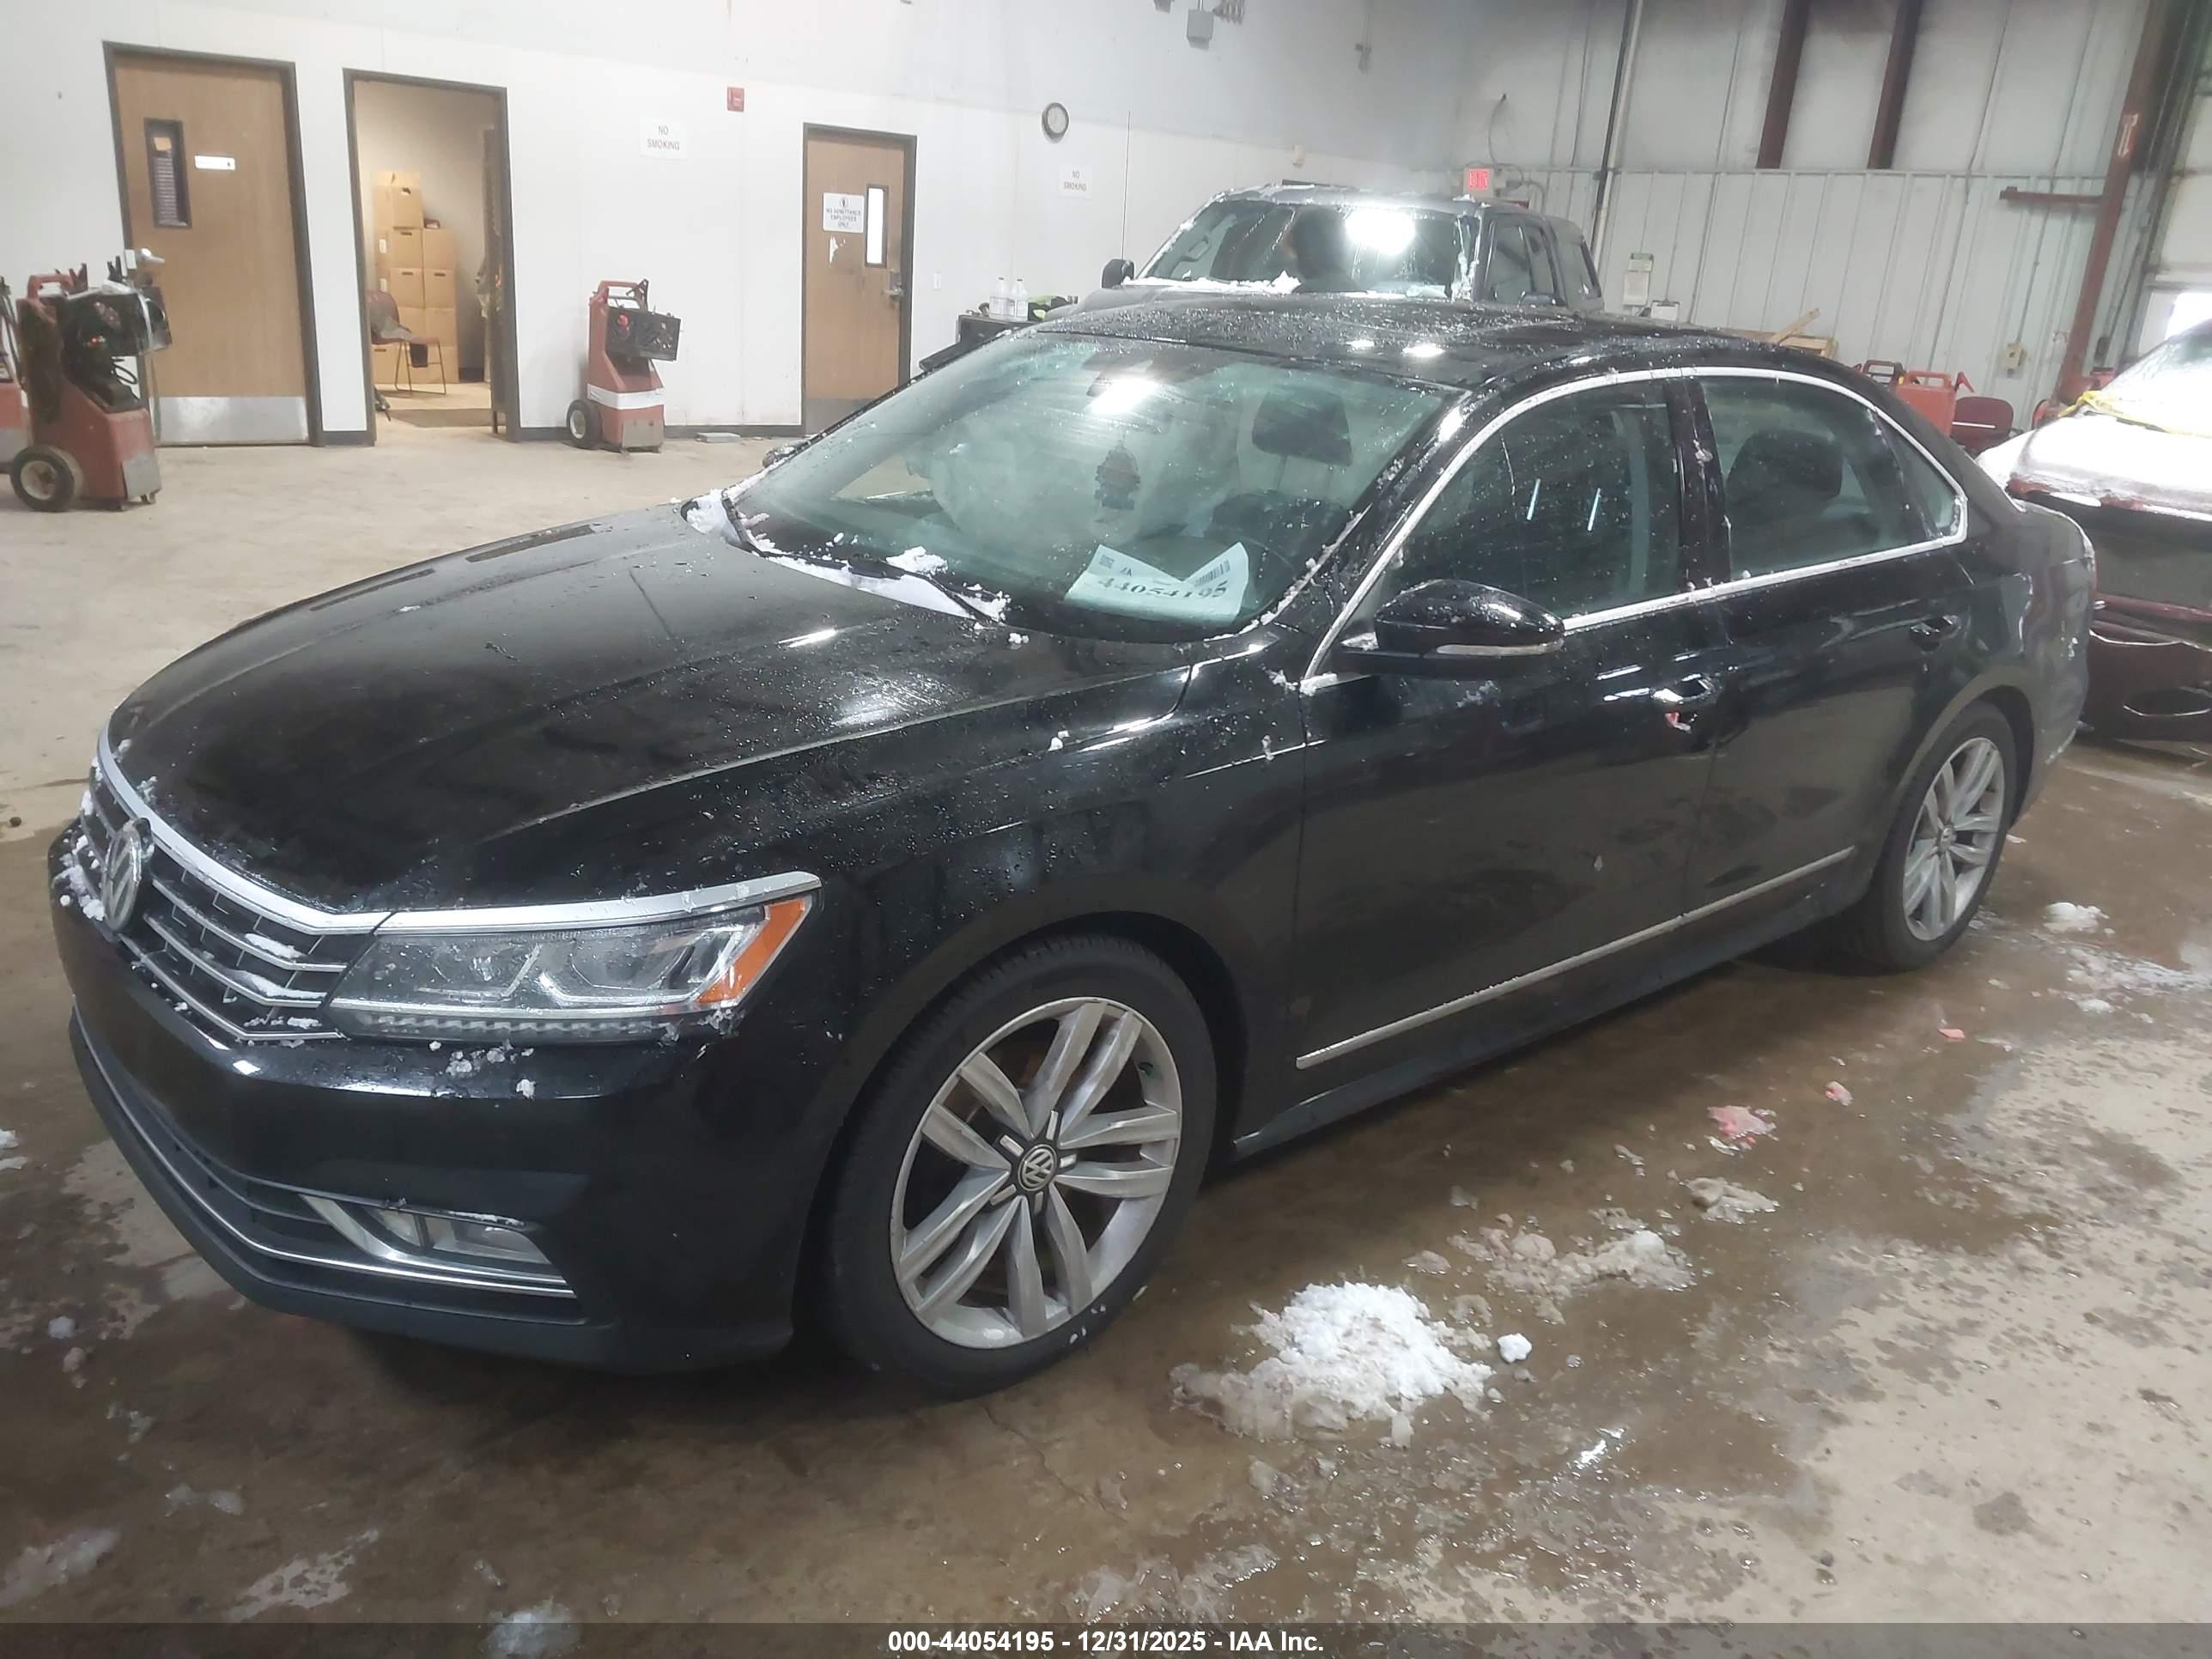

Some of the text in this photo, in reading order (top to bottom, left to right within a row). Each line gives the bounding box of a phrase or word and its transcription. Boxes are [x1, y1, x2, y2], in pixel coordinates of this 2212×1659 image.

[658, 125, 669, 136] NO
[647, 138, 680, 151] SMOKING
[1072, 170, 1080, 179] NO
[1063, 181, 1087, 191] SMOKING
